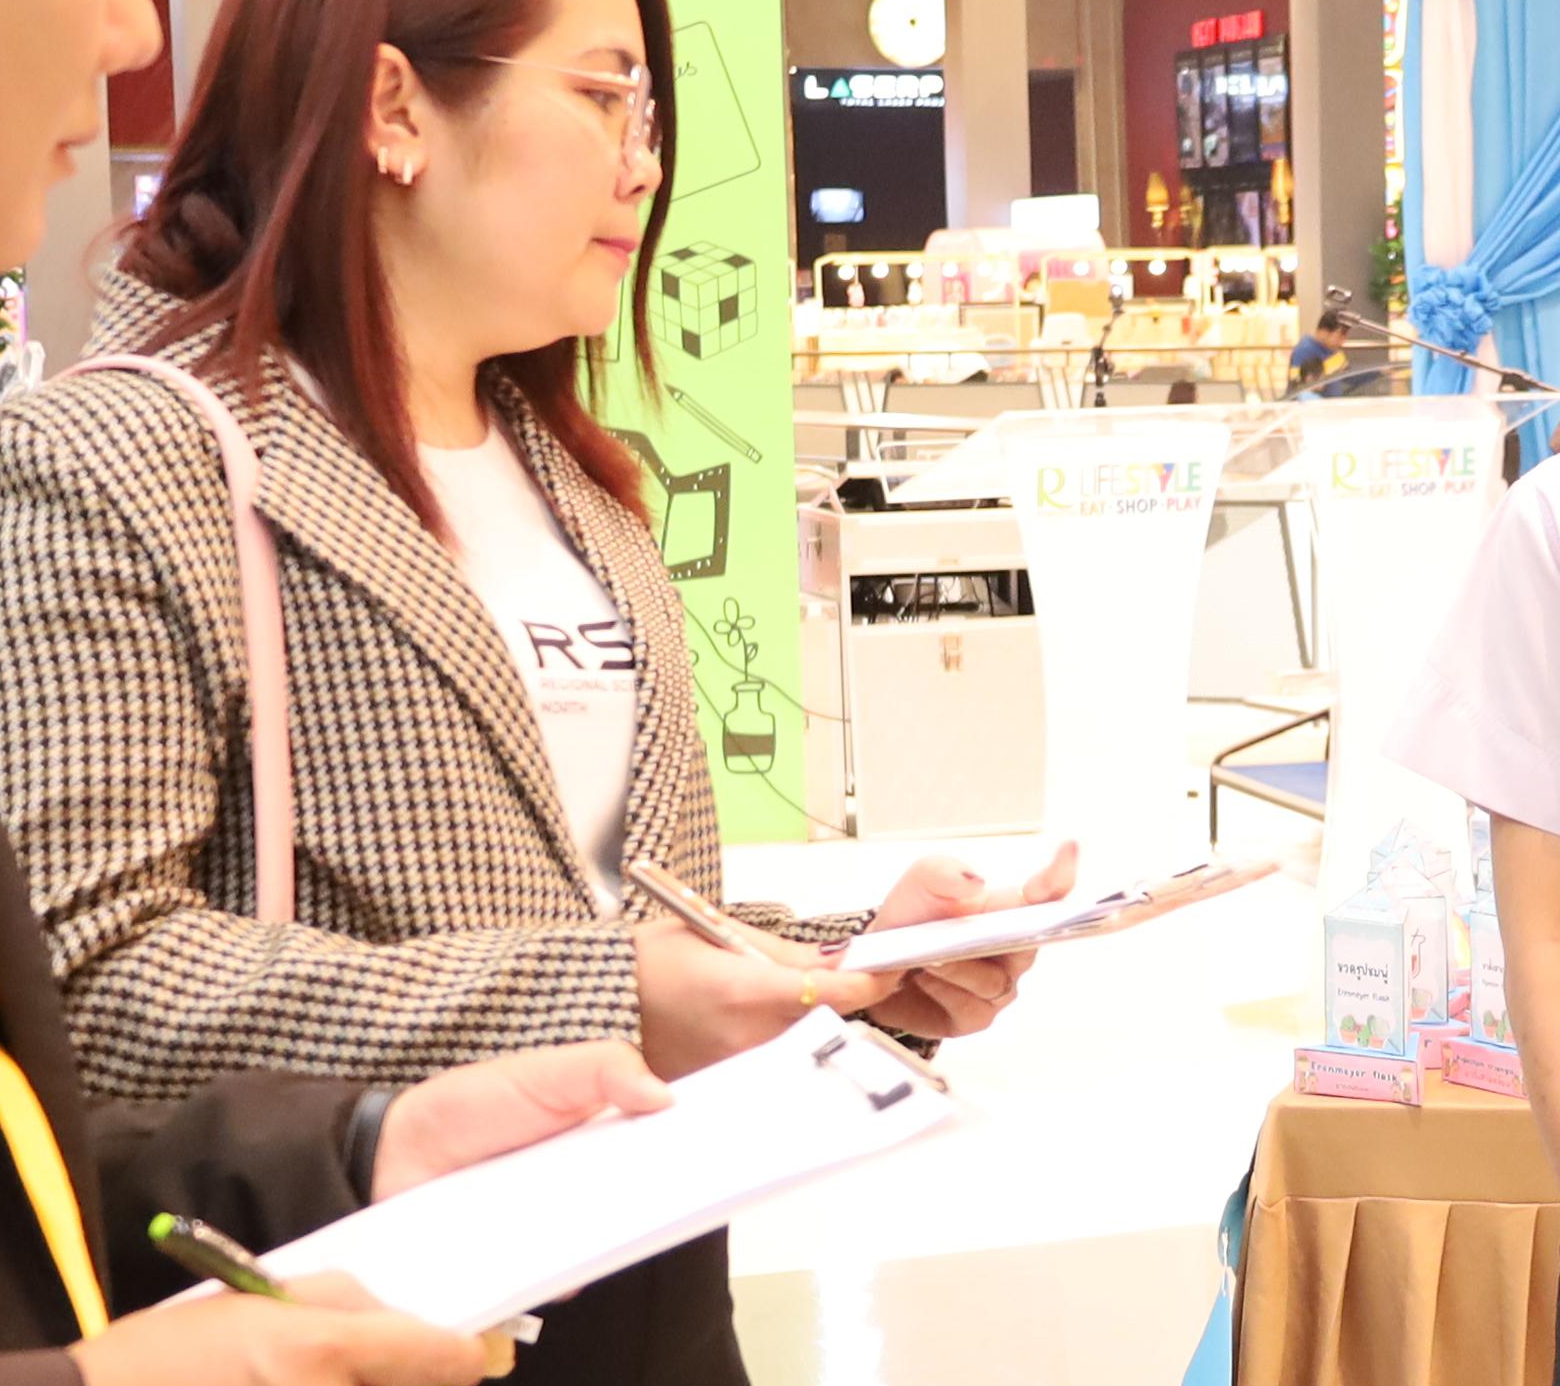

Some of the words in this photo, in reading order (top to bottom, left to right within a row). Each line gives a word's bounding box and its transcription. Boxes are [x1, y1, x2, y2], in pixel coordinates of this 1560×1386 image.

[1080, 461, 1202, 496] LIFESTYLE
[1401, 481, 1437, 497] SHOP
[1080, 500, 1107, 517] EAT
[1116, 497, 1158, 514] SHOP
[1166, 495, 1202, 512] PLAY
